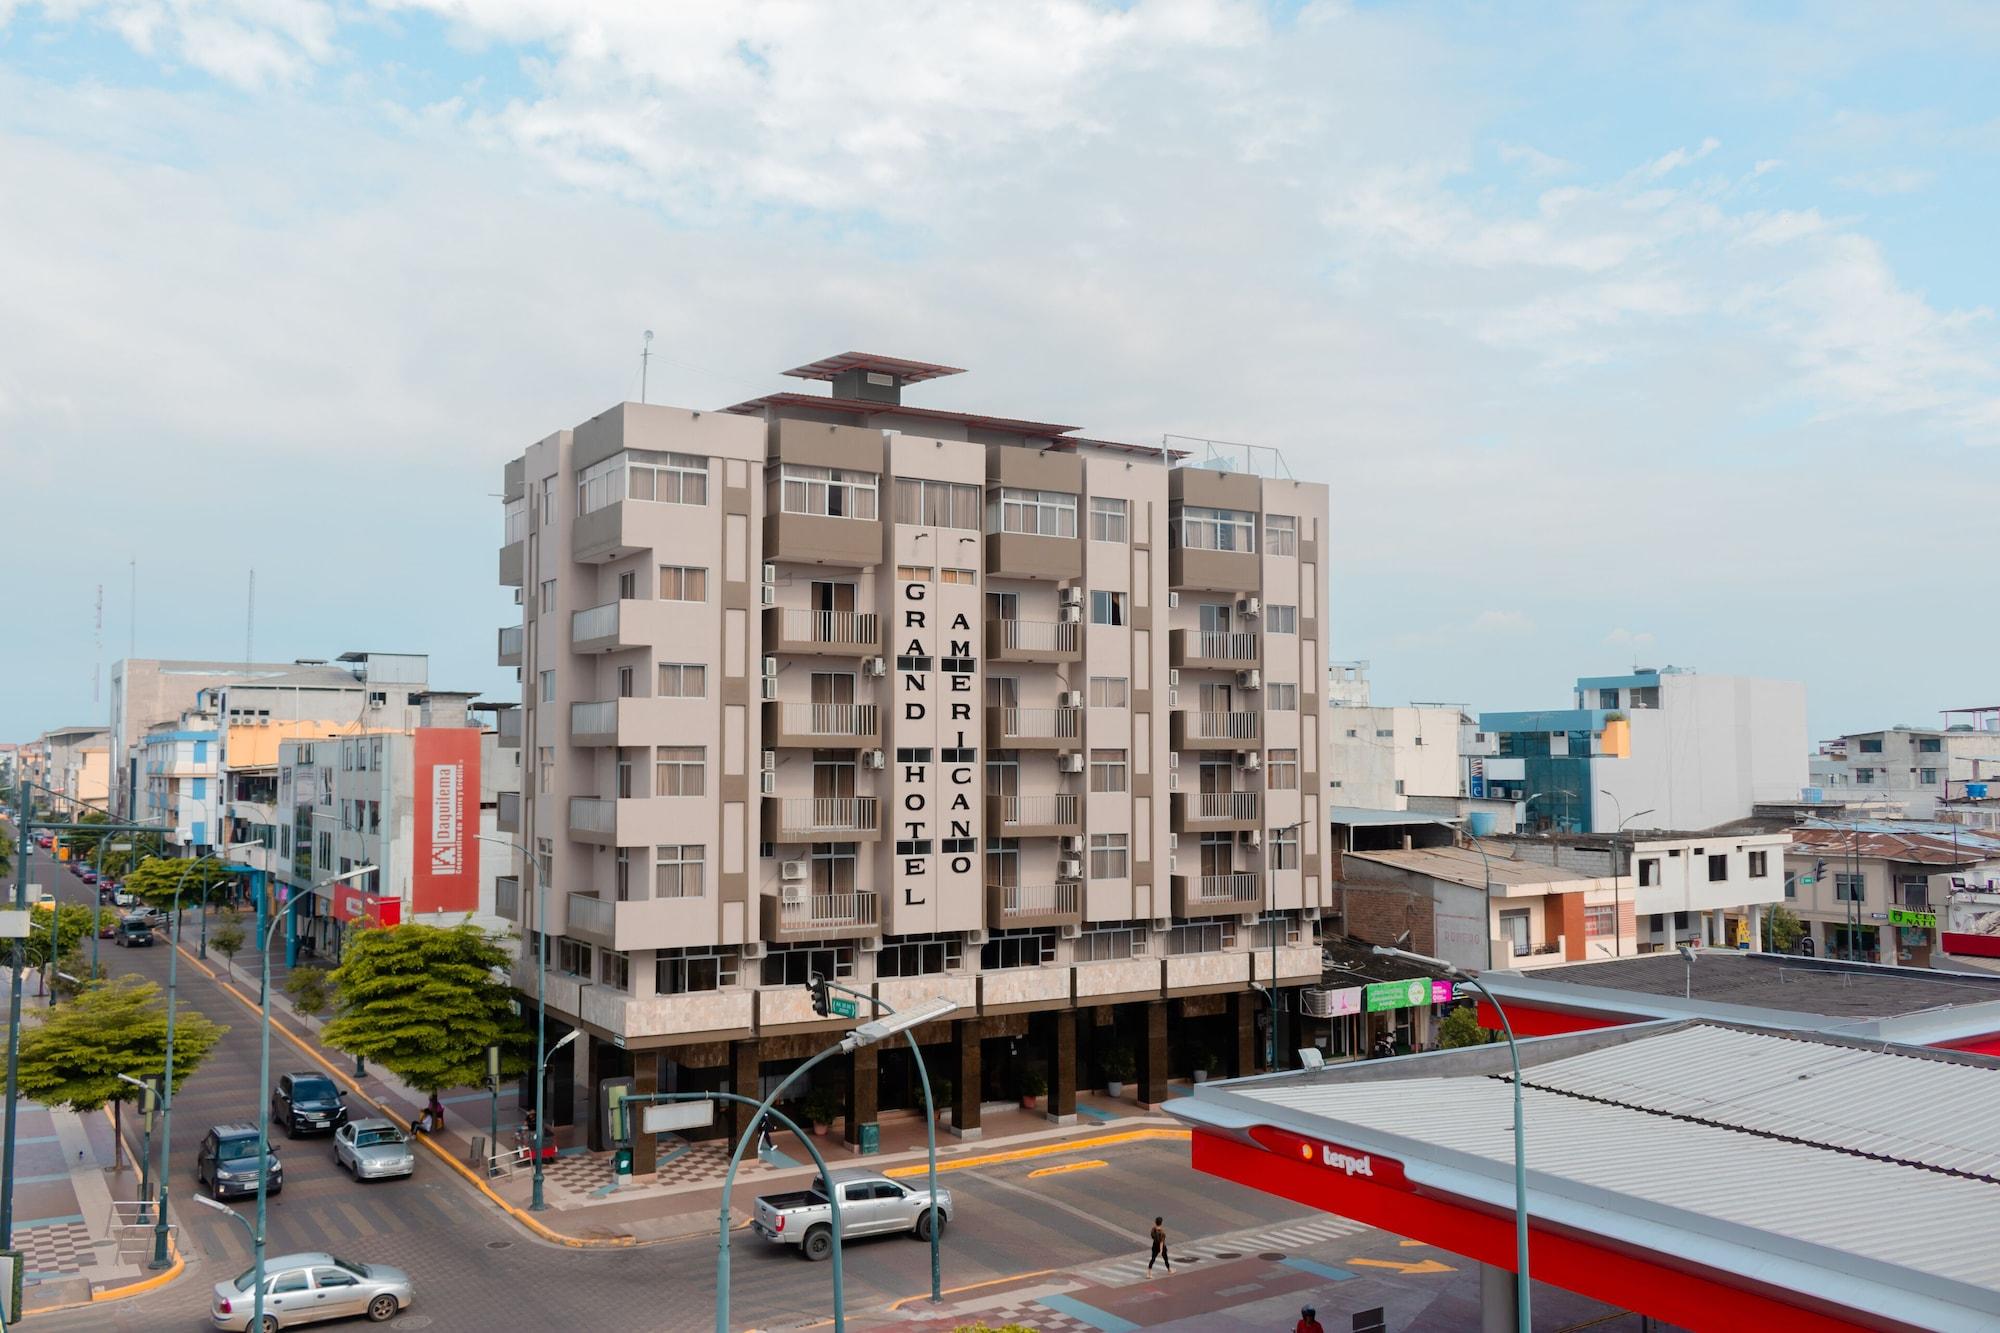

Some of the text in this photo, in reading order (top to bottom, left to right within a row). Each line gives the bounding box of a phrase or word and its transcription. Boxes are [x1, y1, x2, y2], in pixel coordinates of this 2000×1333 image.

[436, 769, 452, 839] Daquilema
[905, 583, 926, 906] GRAND HOTEL
[950, 612, 972, 874] AMERICANO
[1323, 1145, 1374, 1176] terpel
